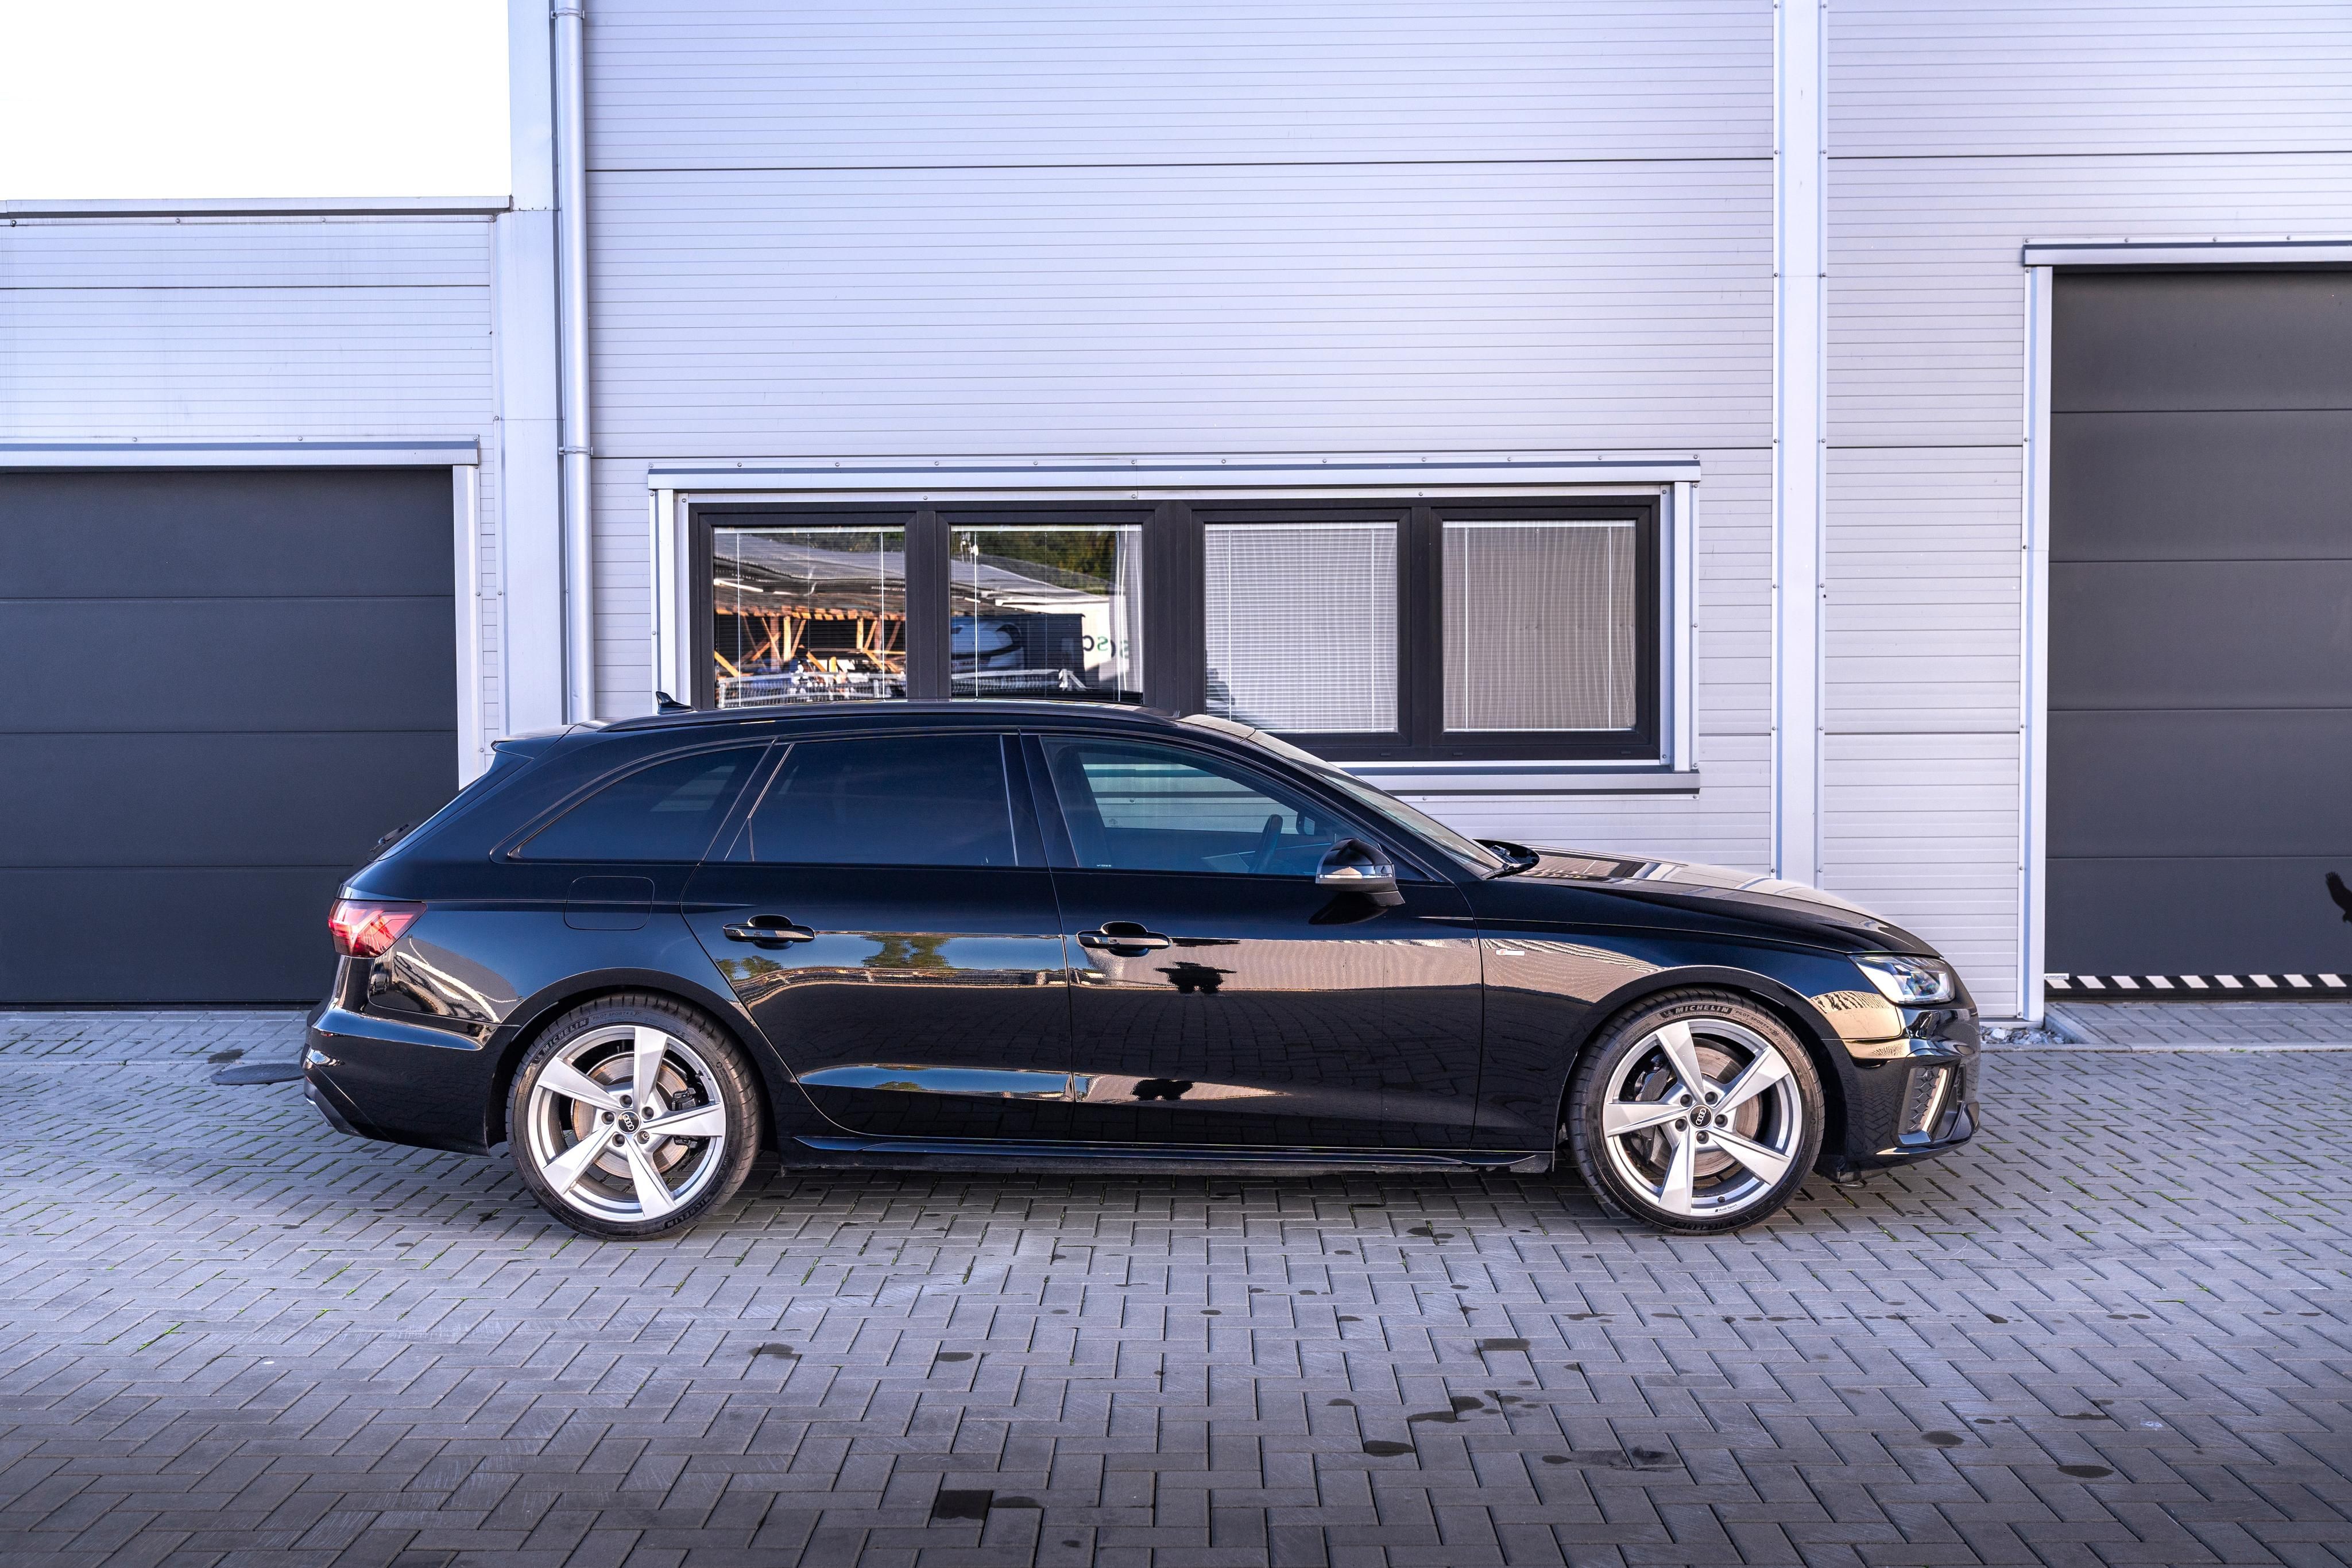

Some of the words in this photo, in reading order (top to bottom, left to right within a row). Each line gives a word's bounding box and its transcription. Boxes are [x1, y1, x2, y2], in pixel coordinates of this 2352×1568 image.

[1675, 1005, 1730, 1014] MICHELIN
[1735, 1010, 1750, 1018] PILOT
[1750, 1016, 1767, 1027] SPORT
[542, 1020, 587, 1052] MICHELIN
[667, 1195, 711, 1228] MICHELIN
